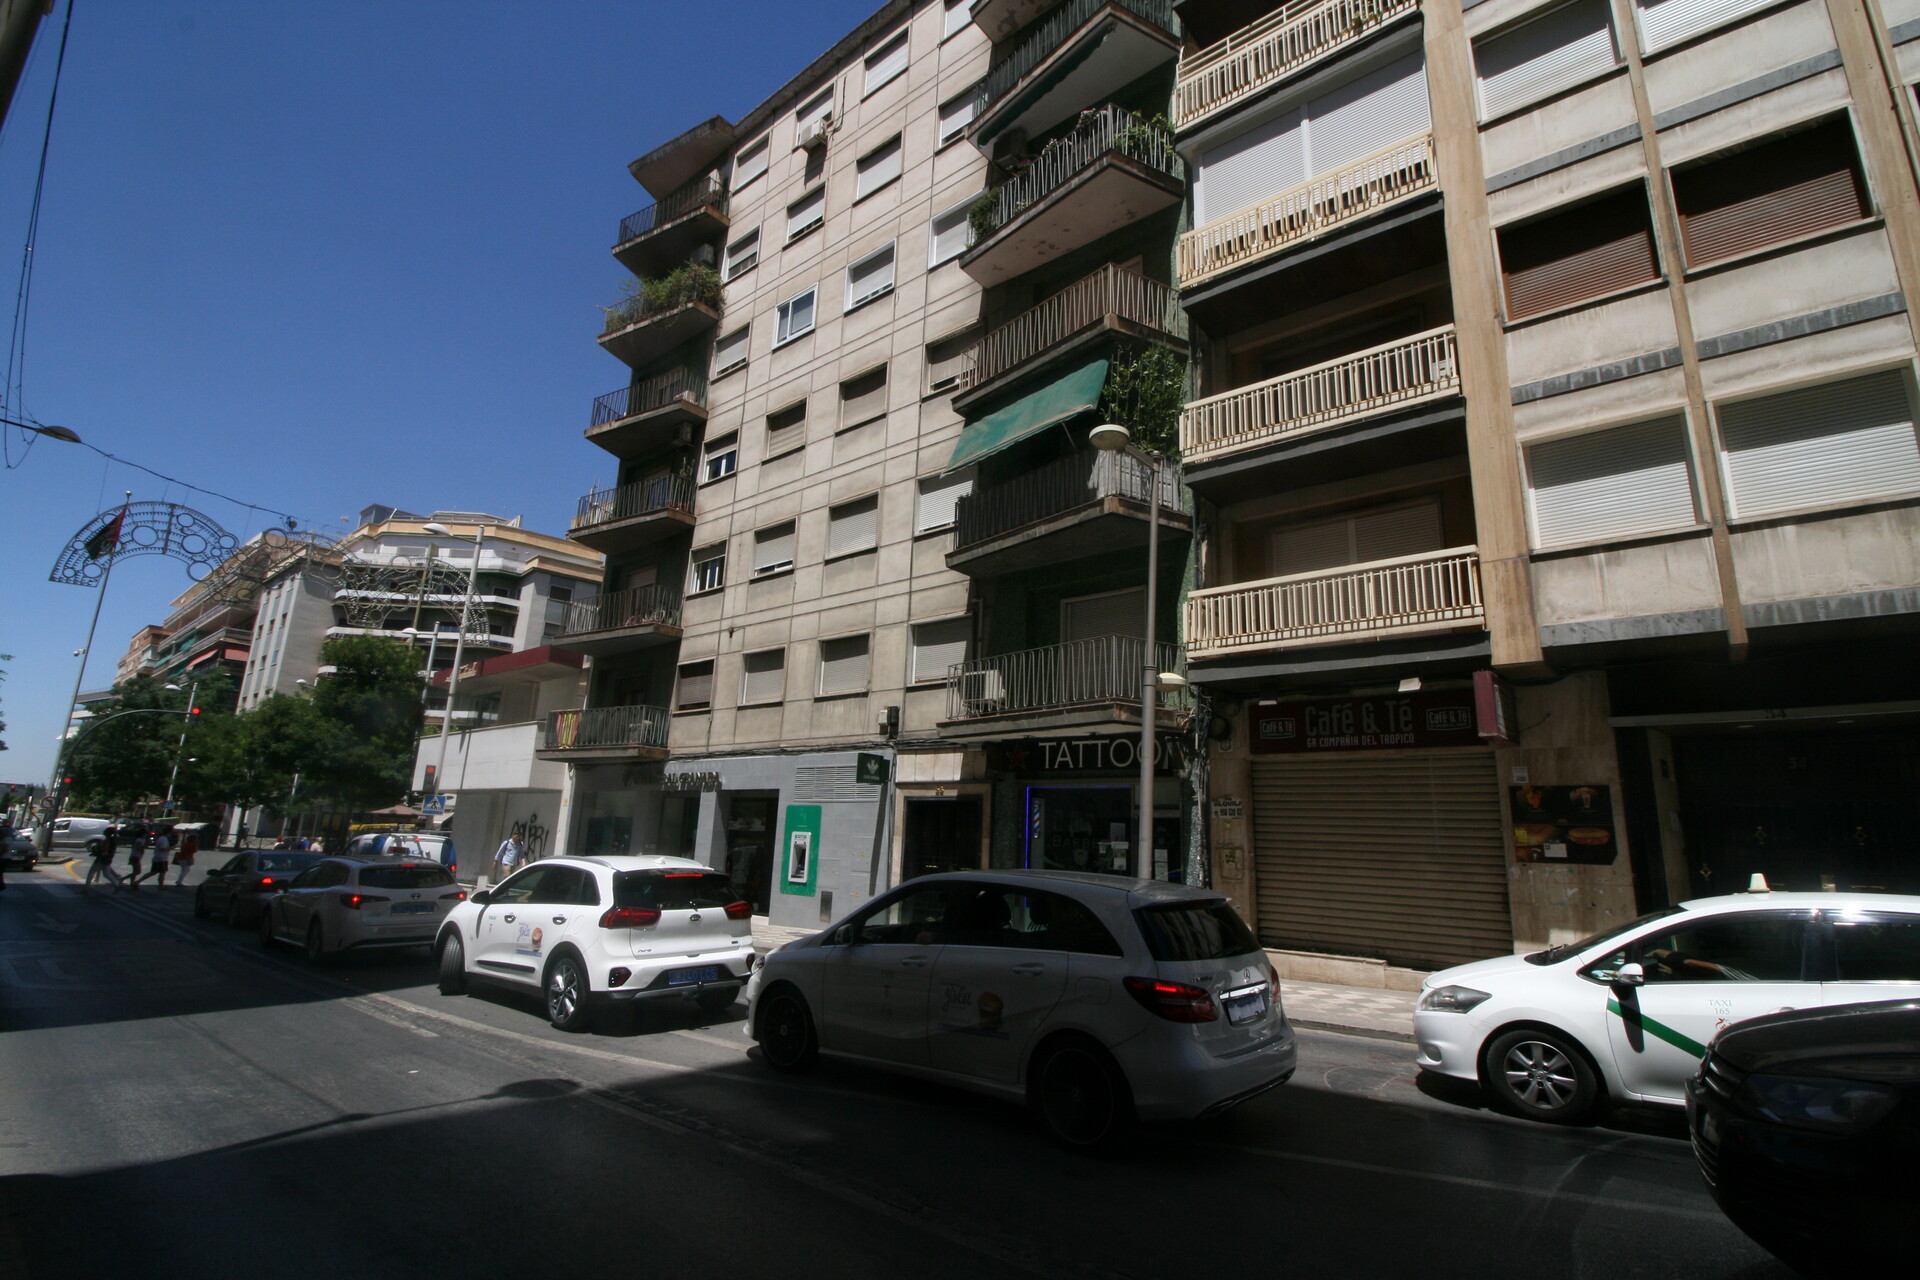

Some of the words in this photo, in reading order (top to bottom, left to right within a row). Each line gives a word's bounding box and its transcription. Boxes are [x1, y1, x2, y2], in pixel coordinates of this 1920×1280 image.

[1304, 702, 1354, 736] Café
[1361, 702, 1381, 734] &
[1384, 698, 1414, 733] Té
[1319, 734, 1359, 748] COMPAÑIA
[1361, 734, 1377, 746] DEL
[1379, 732, 1415, 745] TROPICO
[1707, 999, 1733, 1007] TAXI
[1714, 1007, 1730, 1015] 165
